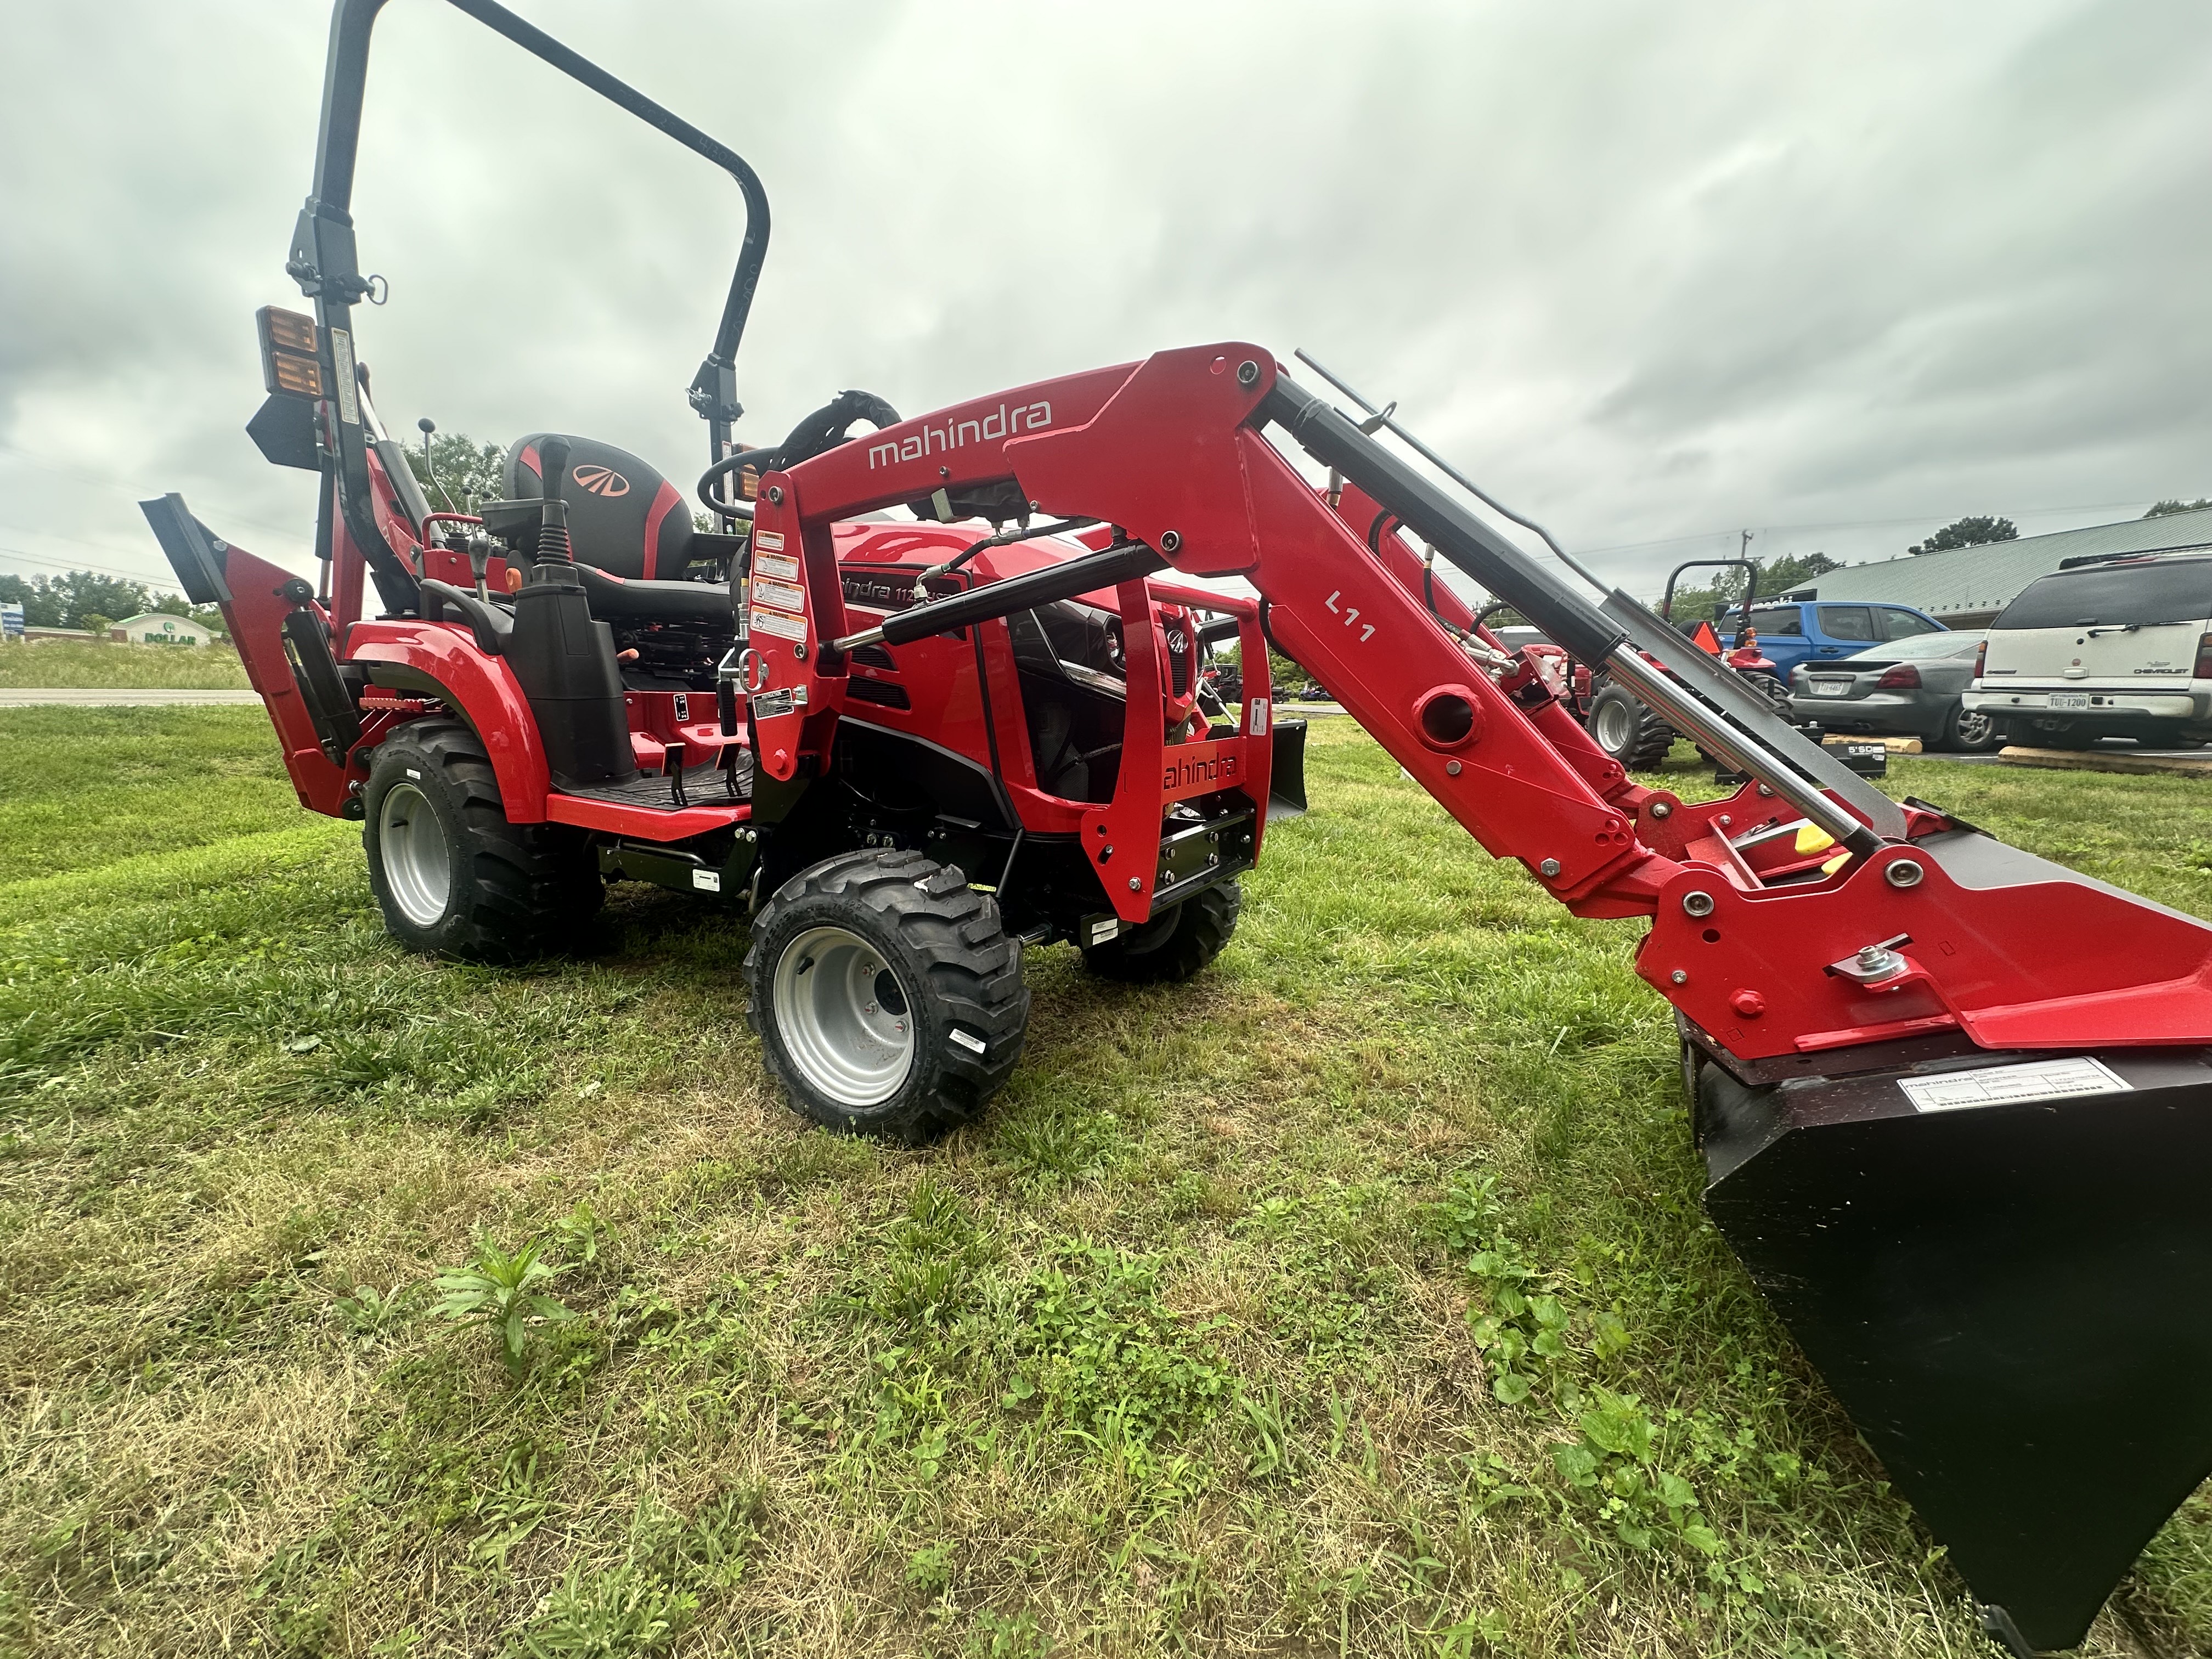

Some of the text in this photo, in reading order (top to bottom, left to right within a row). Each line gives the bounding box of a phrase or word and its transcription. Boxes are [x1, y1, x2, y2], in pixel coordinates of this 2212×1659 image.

[869, 401, 1052, 470] mahindra
[842, 578, 890, 599] indra
[1324, 590, 1376, 642] L11
[145, 633, 196, 646] DOLLAR
[1163, 752, 1237, 791] ahindra
[1905, 1077, 1973, 1088] mahindra
